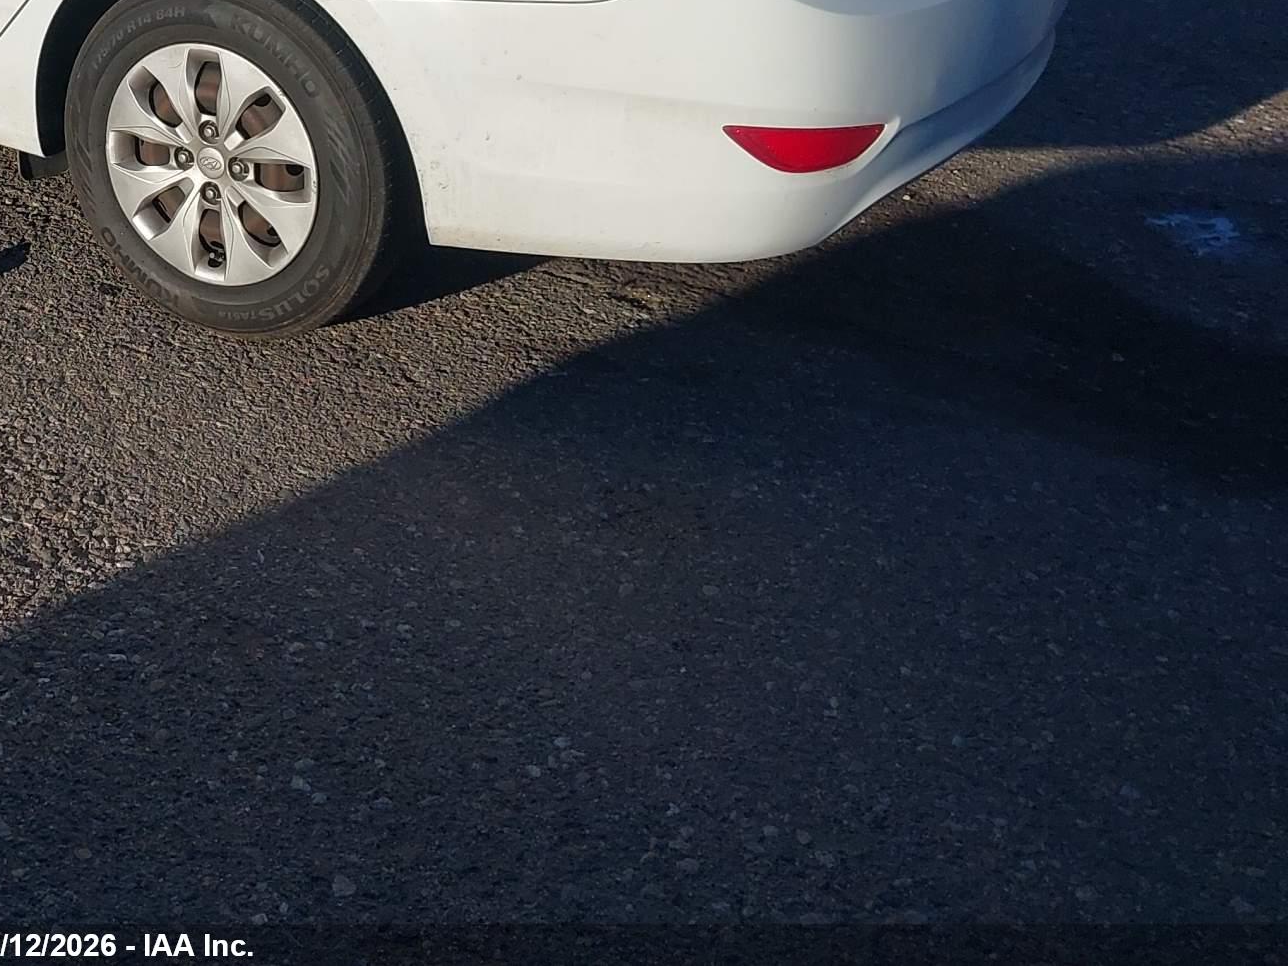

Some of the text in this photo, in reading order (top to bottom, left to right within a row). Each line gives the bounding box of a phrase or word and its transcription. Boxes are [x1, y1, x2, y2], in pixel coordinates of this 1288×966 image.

[126, 13, 152, 33] R14
[231, 13, 320, 99] KUMHO
[258, 264, 331, 321] SOLUS
